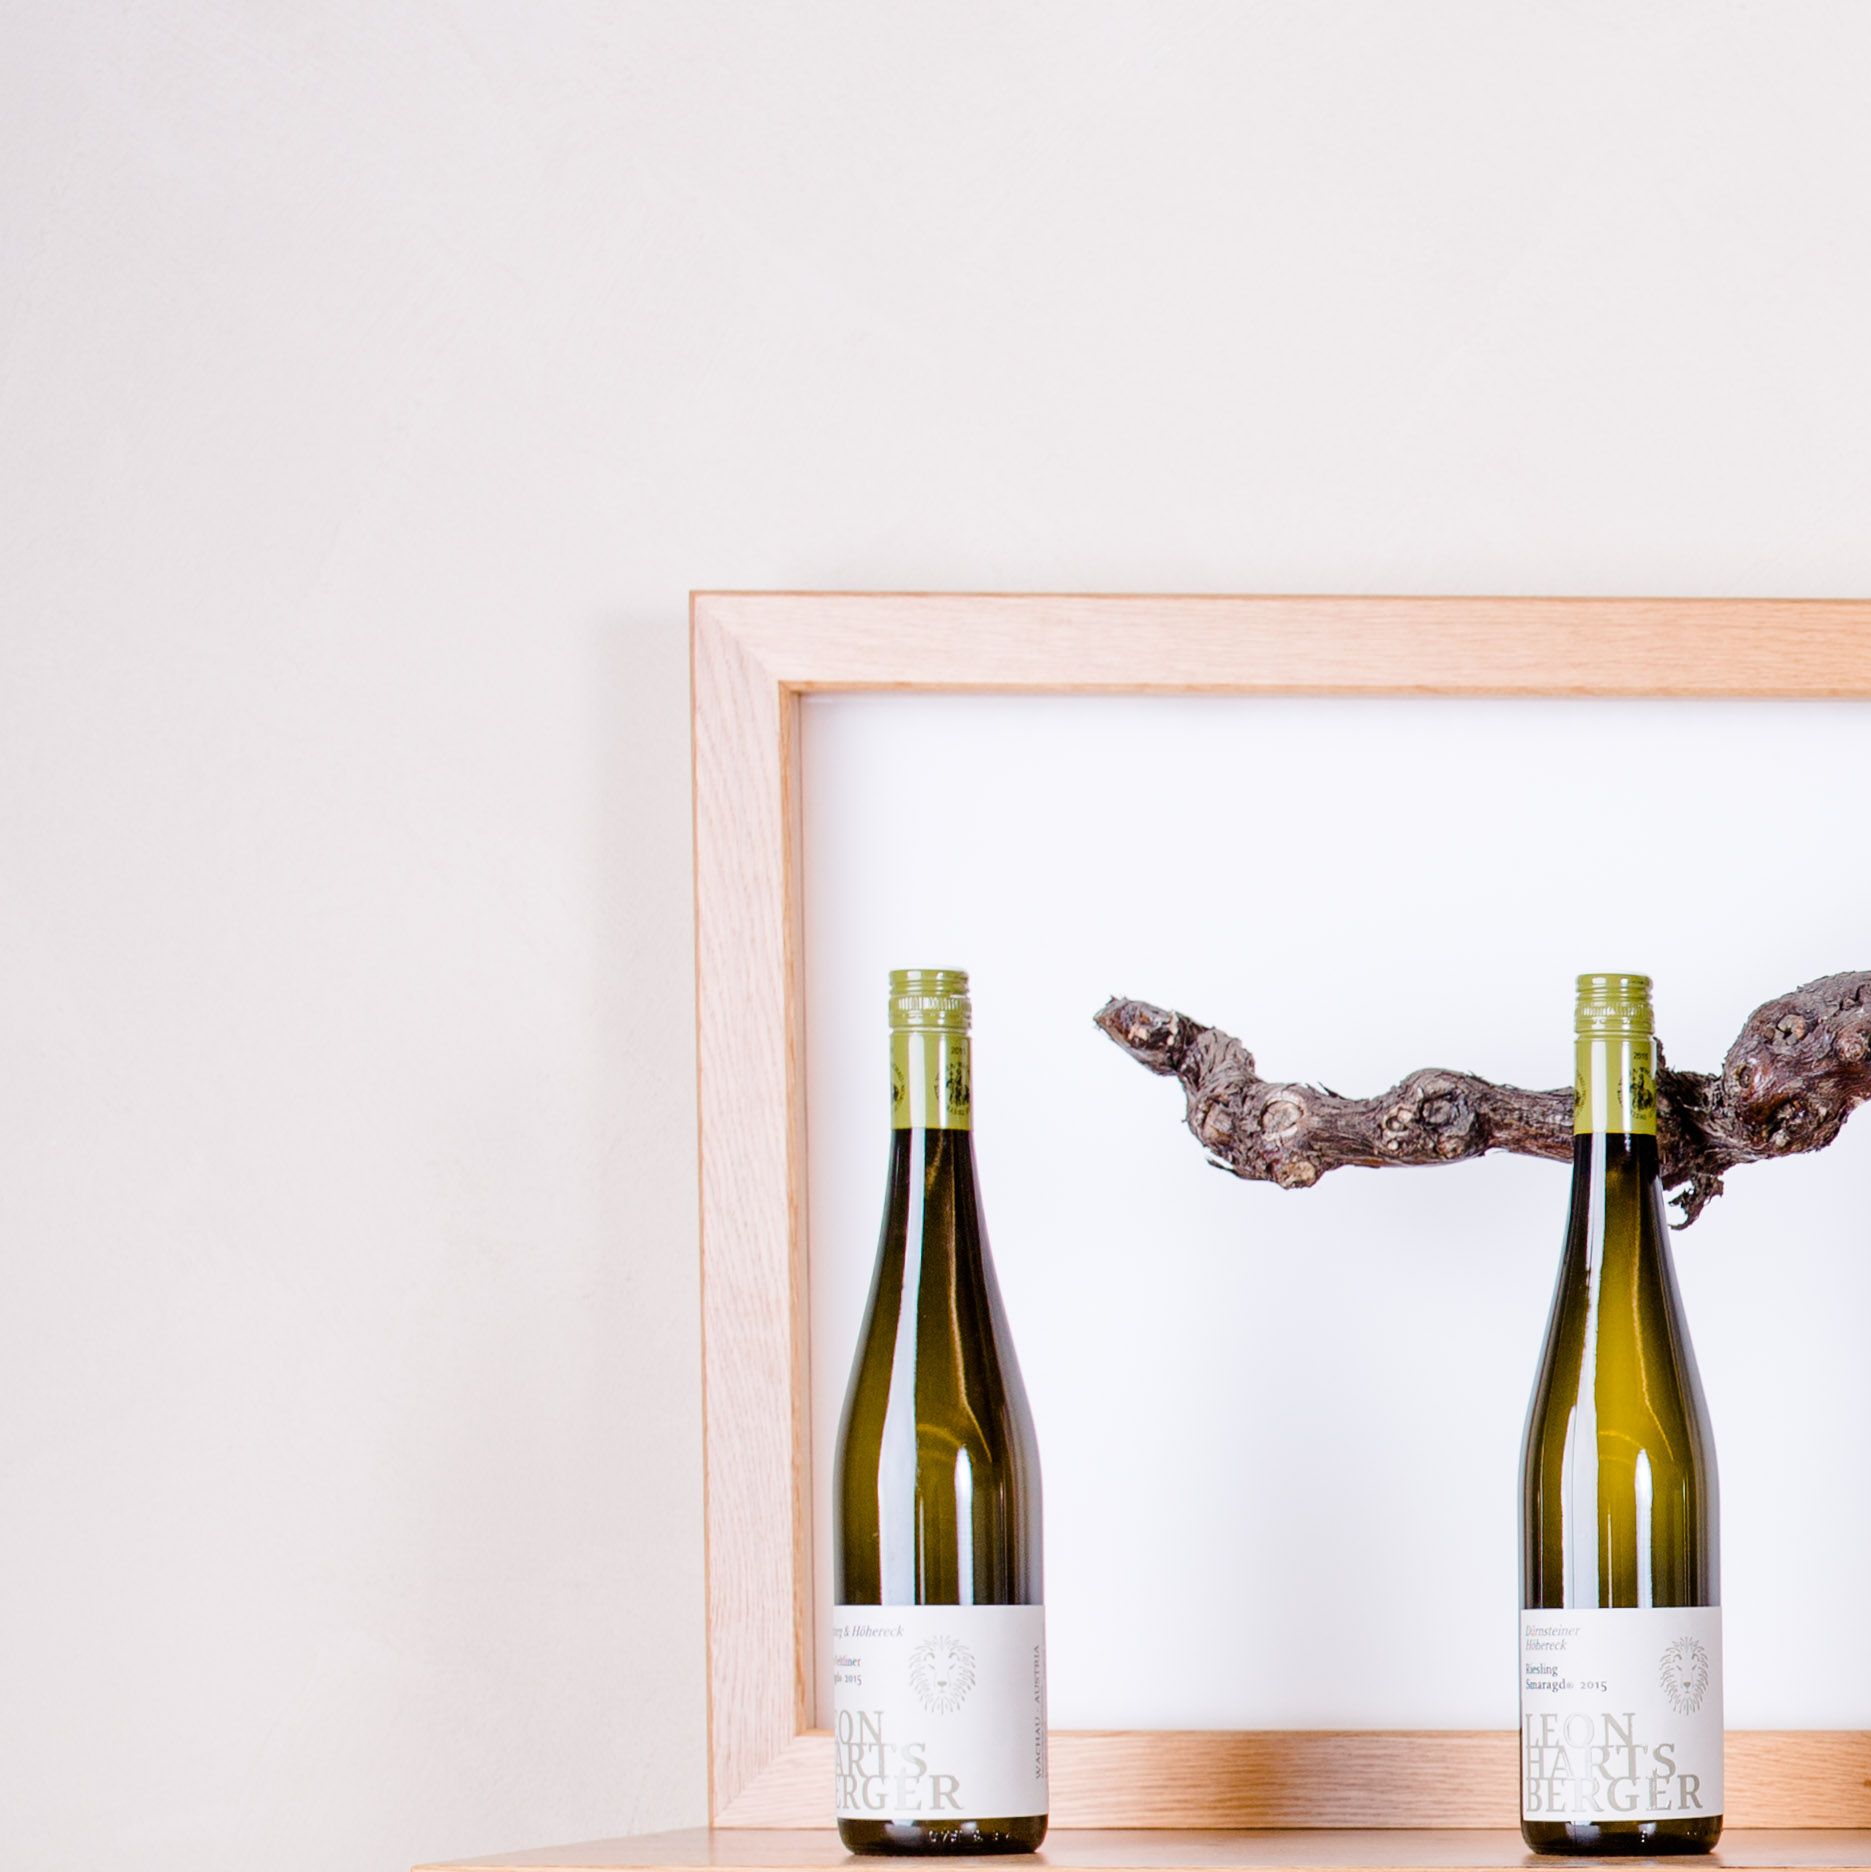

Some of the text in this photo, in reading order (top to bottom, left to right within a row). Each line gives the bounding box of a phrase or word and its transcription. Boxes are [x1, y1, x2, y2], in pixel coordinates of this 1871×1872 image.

[1525, 1663, 1559, 1677] Riesling
[1580, 1680, 1608, 1692] 2015
[837, 1709, 885, 1745] ON
[1525, 1712, 1636, 1748] LEON
[1526, 1744, 1677, 1781] HARTS
[1526, 1774, 1704, 1813] BERGER
